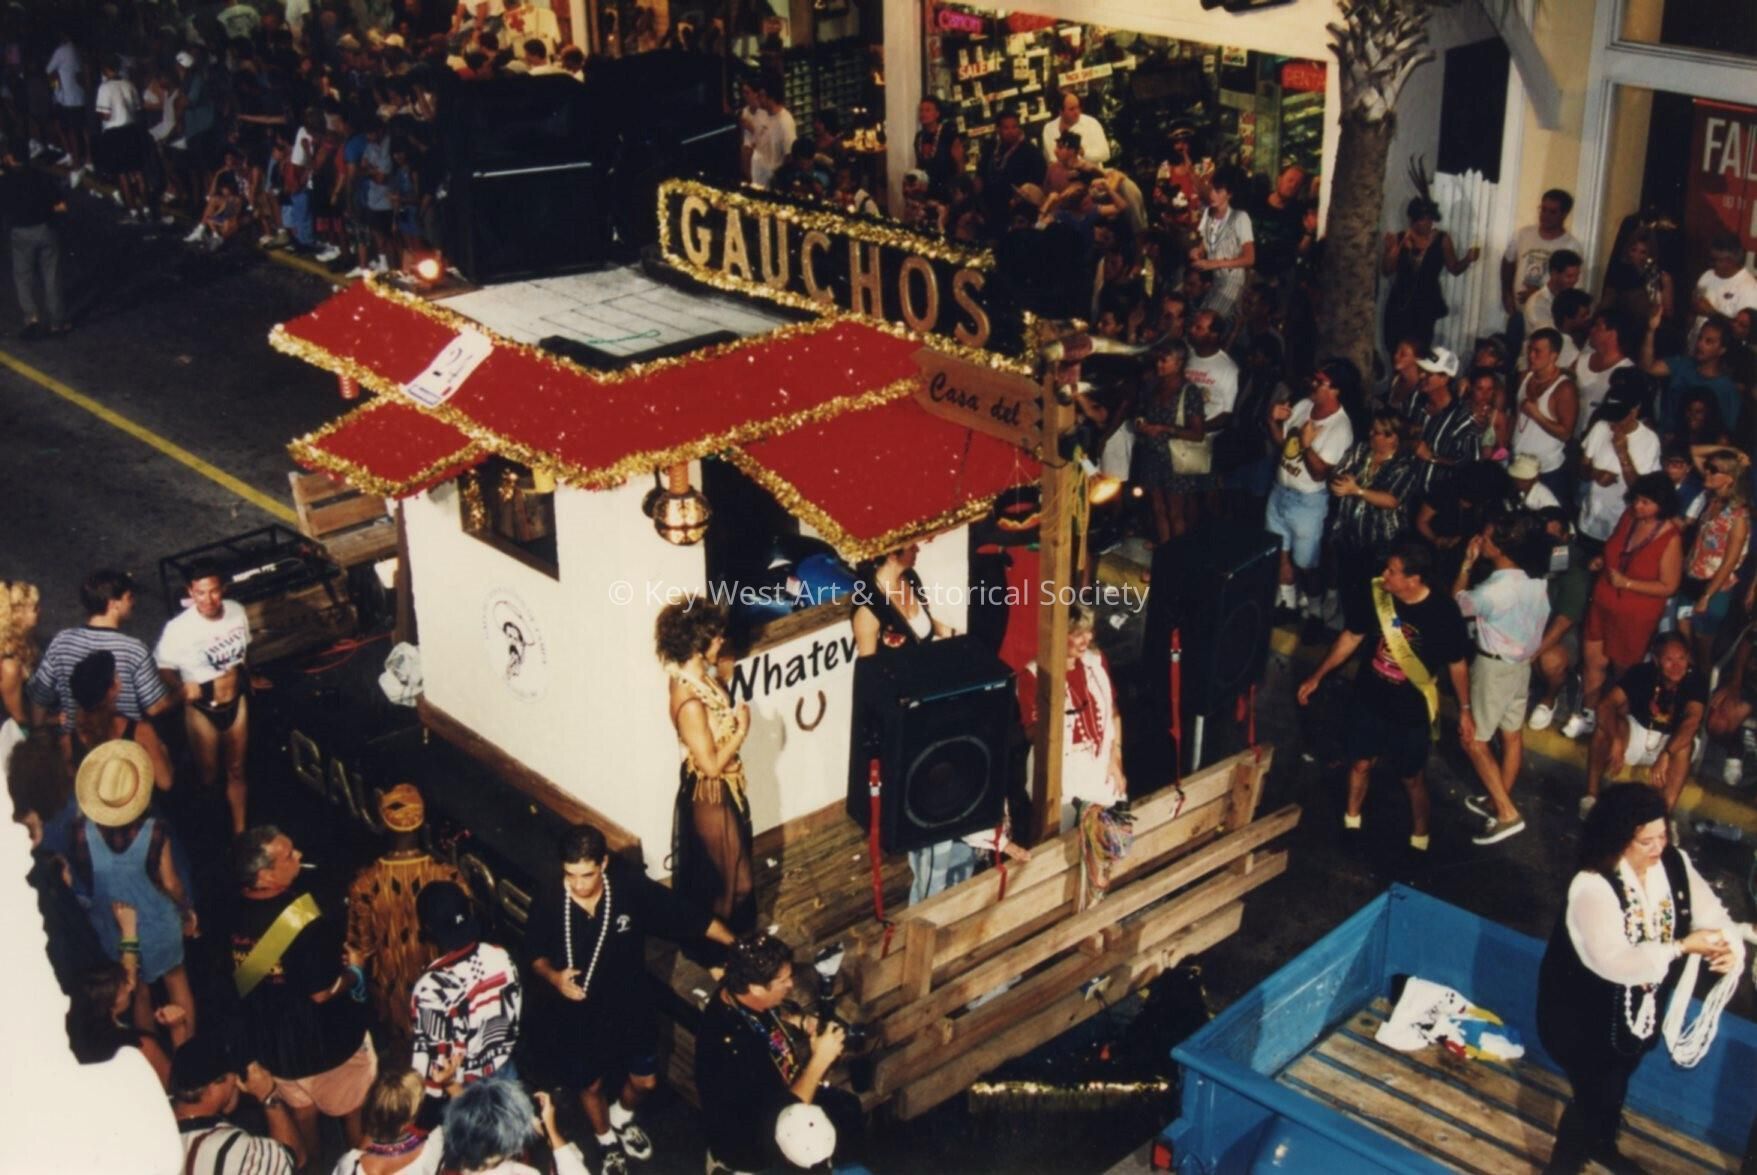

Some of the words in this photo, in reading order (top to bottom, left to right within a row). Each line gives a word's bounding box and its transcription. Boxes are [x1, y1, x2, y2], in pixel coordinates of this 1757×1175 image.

[681, 195, 991, 348] GAUCHOS
[929, 371, 979, 412] Casa
[990, 395, 1021, 426] del
[728, 636, 857, 710] Whatev
